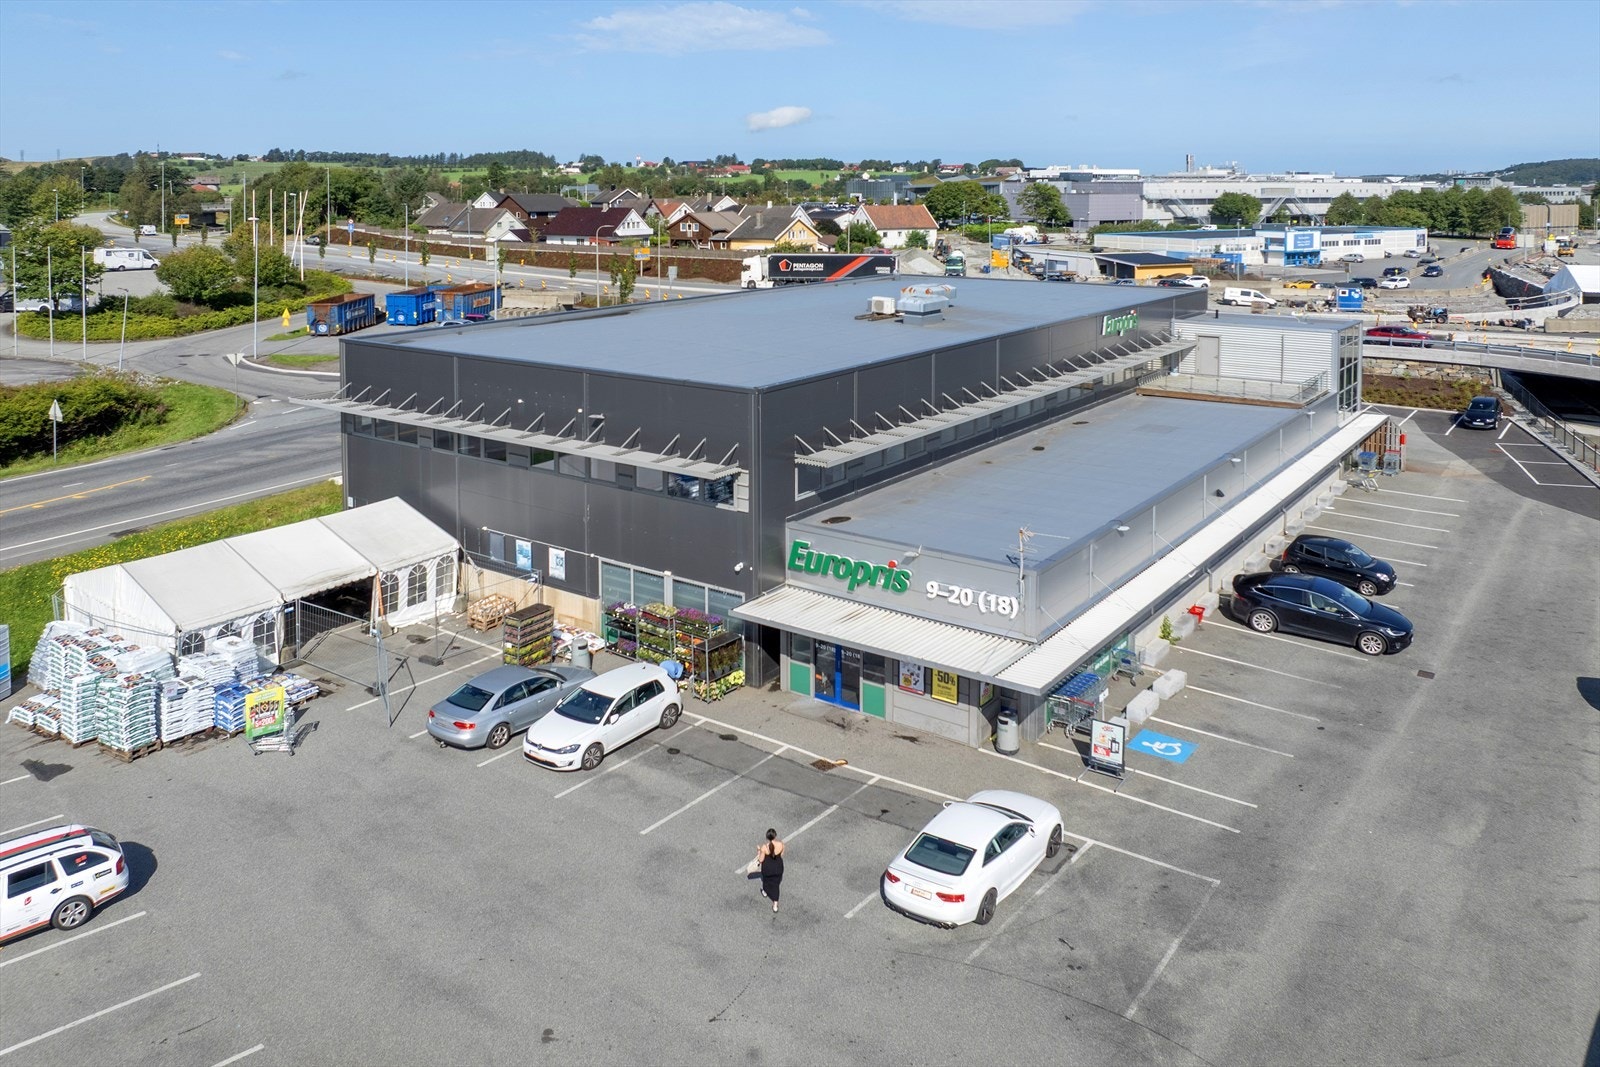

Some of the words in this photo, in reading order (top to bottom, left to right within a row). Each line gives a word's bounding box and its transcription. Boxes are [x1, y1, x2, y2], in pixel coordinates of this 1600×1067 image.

[1102, 310, 1137, 337] Europris
[787, 539, 913, 595] Europris
[978, 591, 1020, 620] (18)
